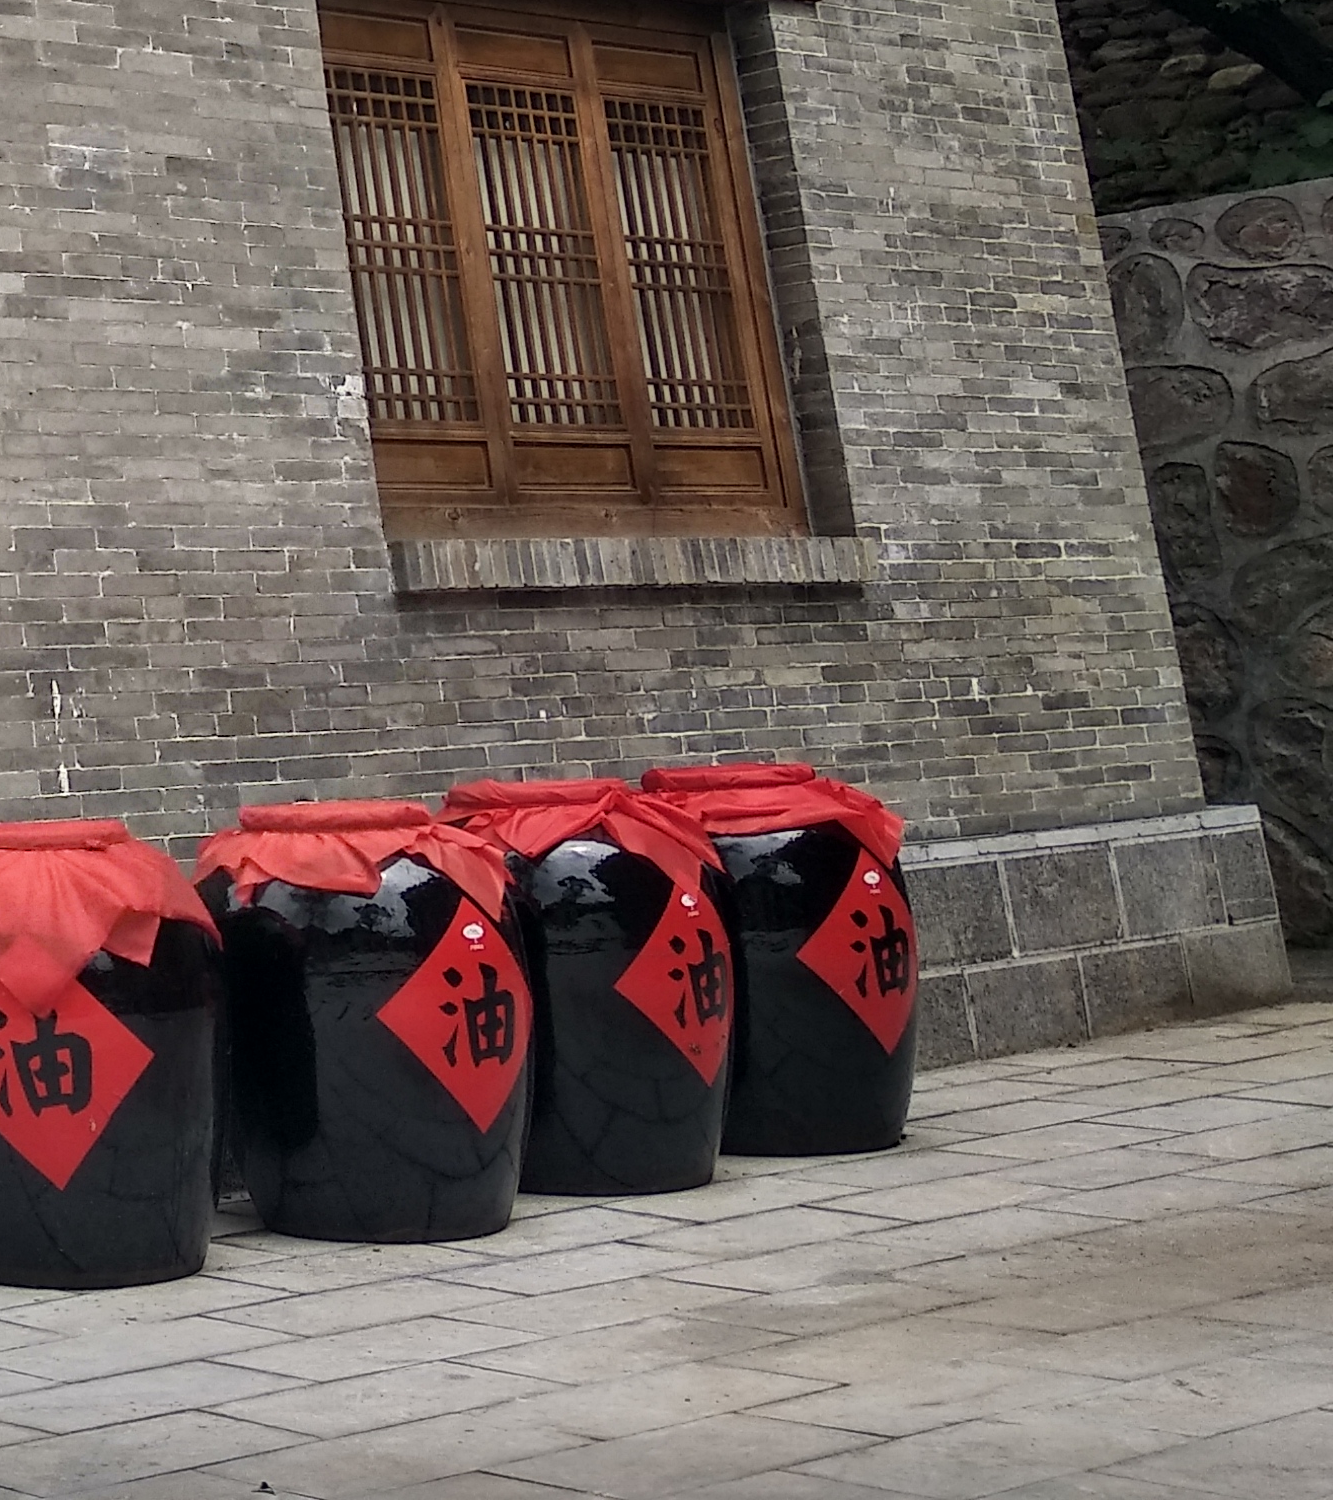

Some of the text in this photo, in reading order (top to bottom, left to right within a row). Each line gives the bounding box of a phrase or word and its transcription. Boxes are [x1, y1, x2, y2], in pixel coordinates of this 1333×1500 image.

[667, 928, 727, 1029] 油
[849, 904, 909, 998] 油
[438, 962, 515, 1068] 油
